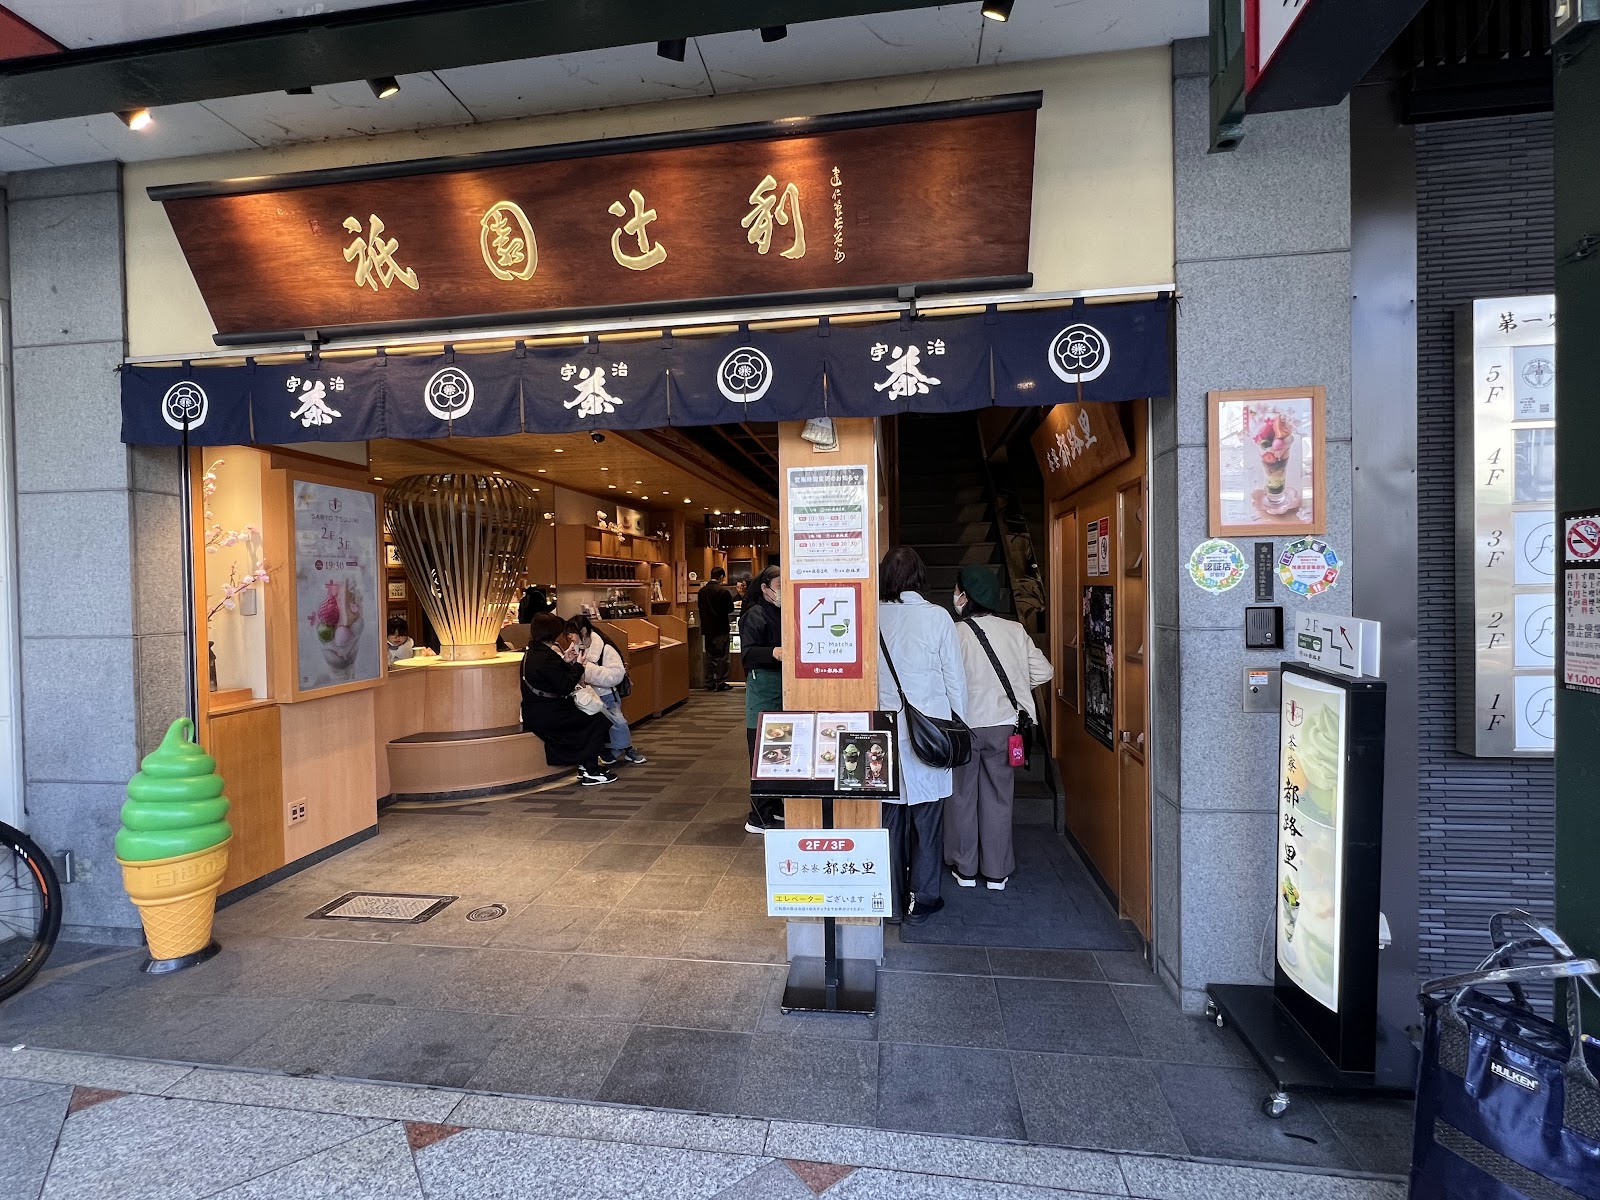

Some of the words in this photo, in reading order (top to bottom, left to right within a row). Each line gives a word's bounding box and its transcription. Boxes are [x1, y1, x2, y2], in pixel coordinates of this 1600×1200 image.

[1304, 617, 1320, 633] 2F
[806, 641, 826, 654] 2F
[775, 895, 823, 903] エレベーター
[826, 895, 865, 904] ございます
